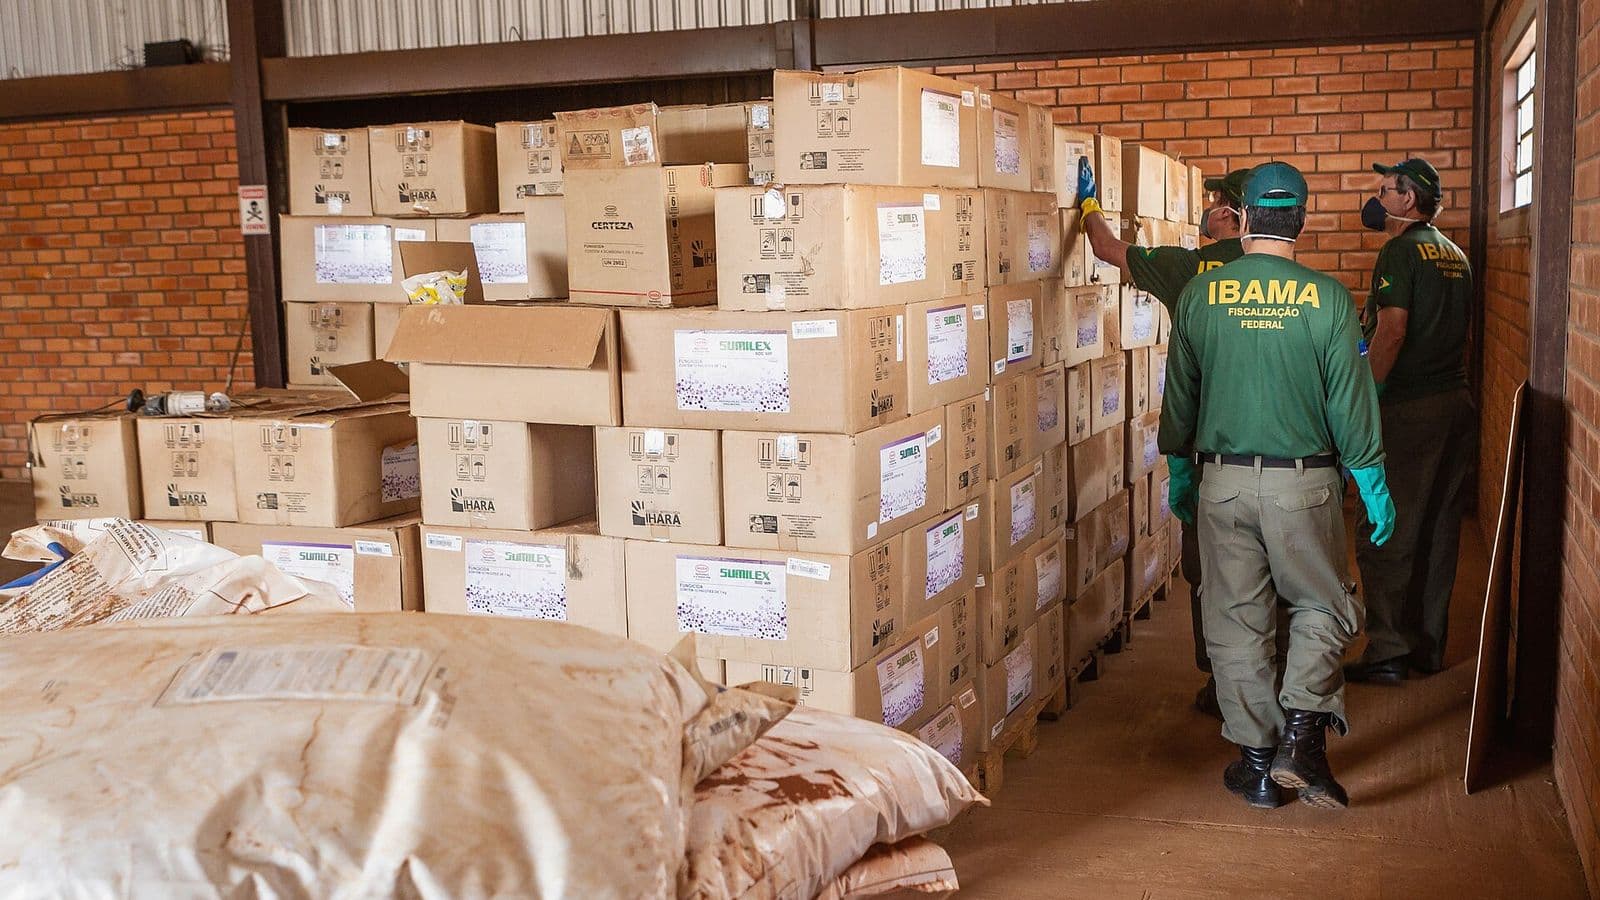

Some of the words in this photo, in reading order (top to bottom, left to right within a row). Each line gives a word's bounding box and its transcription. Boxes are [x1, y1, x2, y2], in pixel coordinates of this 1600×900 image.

[410, 191, 437, 201] IHARA
[591, 221, 634, 230] CERTEZA
[1208, 279, 1320, 309] IBAMA
[1228, 306, 1299, 318] FISCALIZAÇÃO
[1241, 319, 1285, 330] FEDERAL
[719, 341, 772, 351] SUMILEX
[181, 425, 187, 437] 7
[277, 428, 283, 439] 7
[466, 426, 474, 437] 7
[72, 495, 99, 505] IHARA
[179, 493, 207, 505] IHARA
[463, 500, 495, 511] IHARA
[645, 512, 681, 525] IHARA
[299, 551, 340, 562] SUMILEX
[504, 551, 552, 564] SUMILEX
[719, 568, 771, 581] SUMILEX
[783, 669, 792, 681] 7
